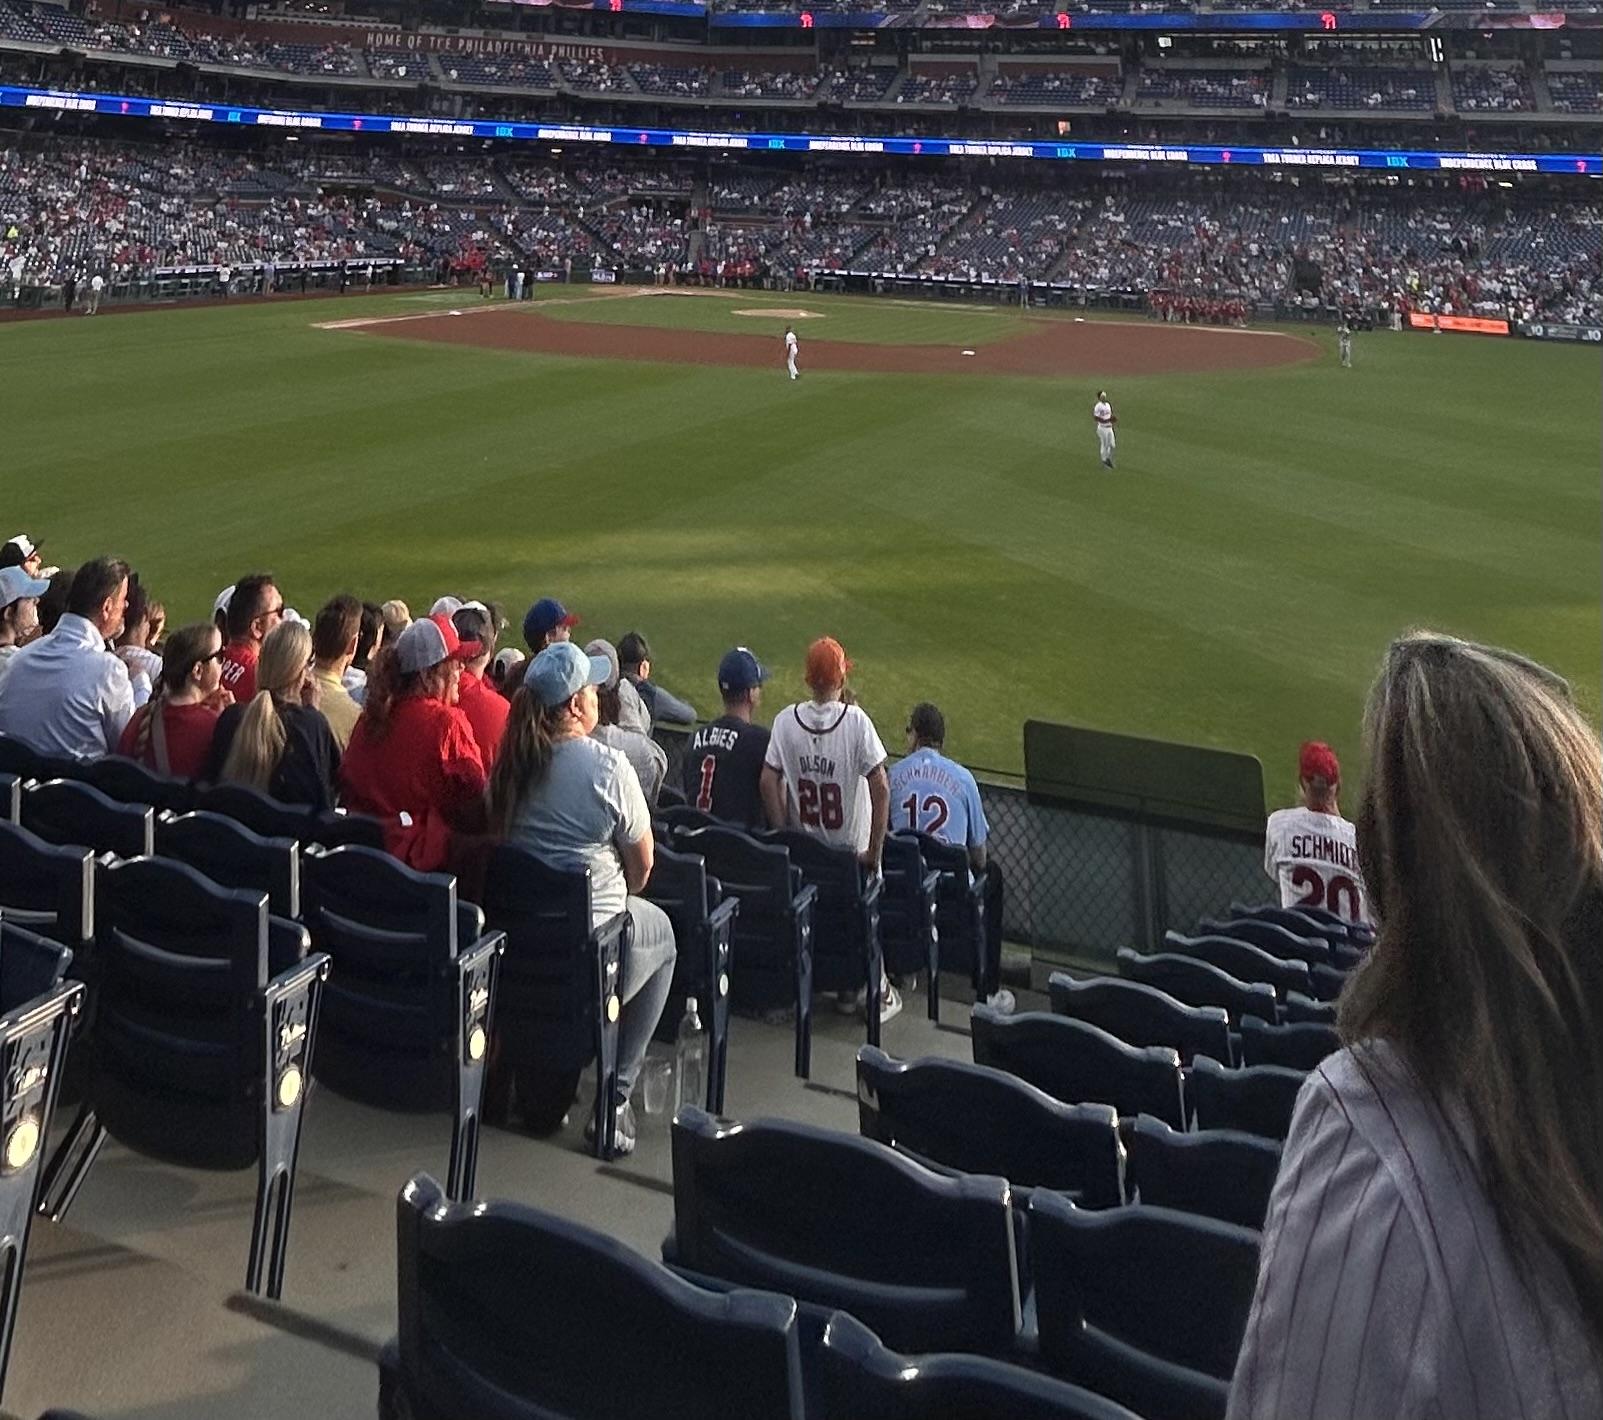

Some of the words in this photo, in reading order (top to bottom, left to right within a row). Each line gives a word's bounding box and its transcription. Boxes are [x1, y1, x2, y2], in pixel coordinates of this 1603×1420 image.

[367, 32, 401, 47] HOME
[407, 35, 422, 50] OF
[221, 659, 246, 685] PER
[693, 727, 739, 751] ALBIES
[799, 754, 836, 778] OLSON
[894, 764, 962, 795] SCHWARBER
[696, 754, 716, 812] 1
[798, 778, 844, 830] 28
[902, 792, 949, 845] 12
[1291, 865, 1361, 921] 20
